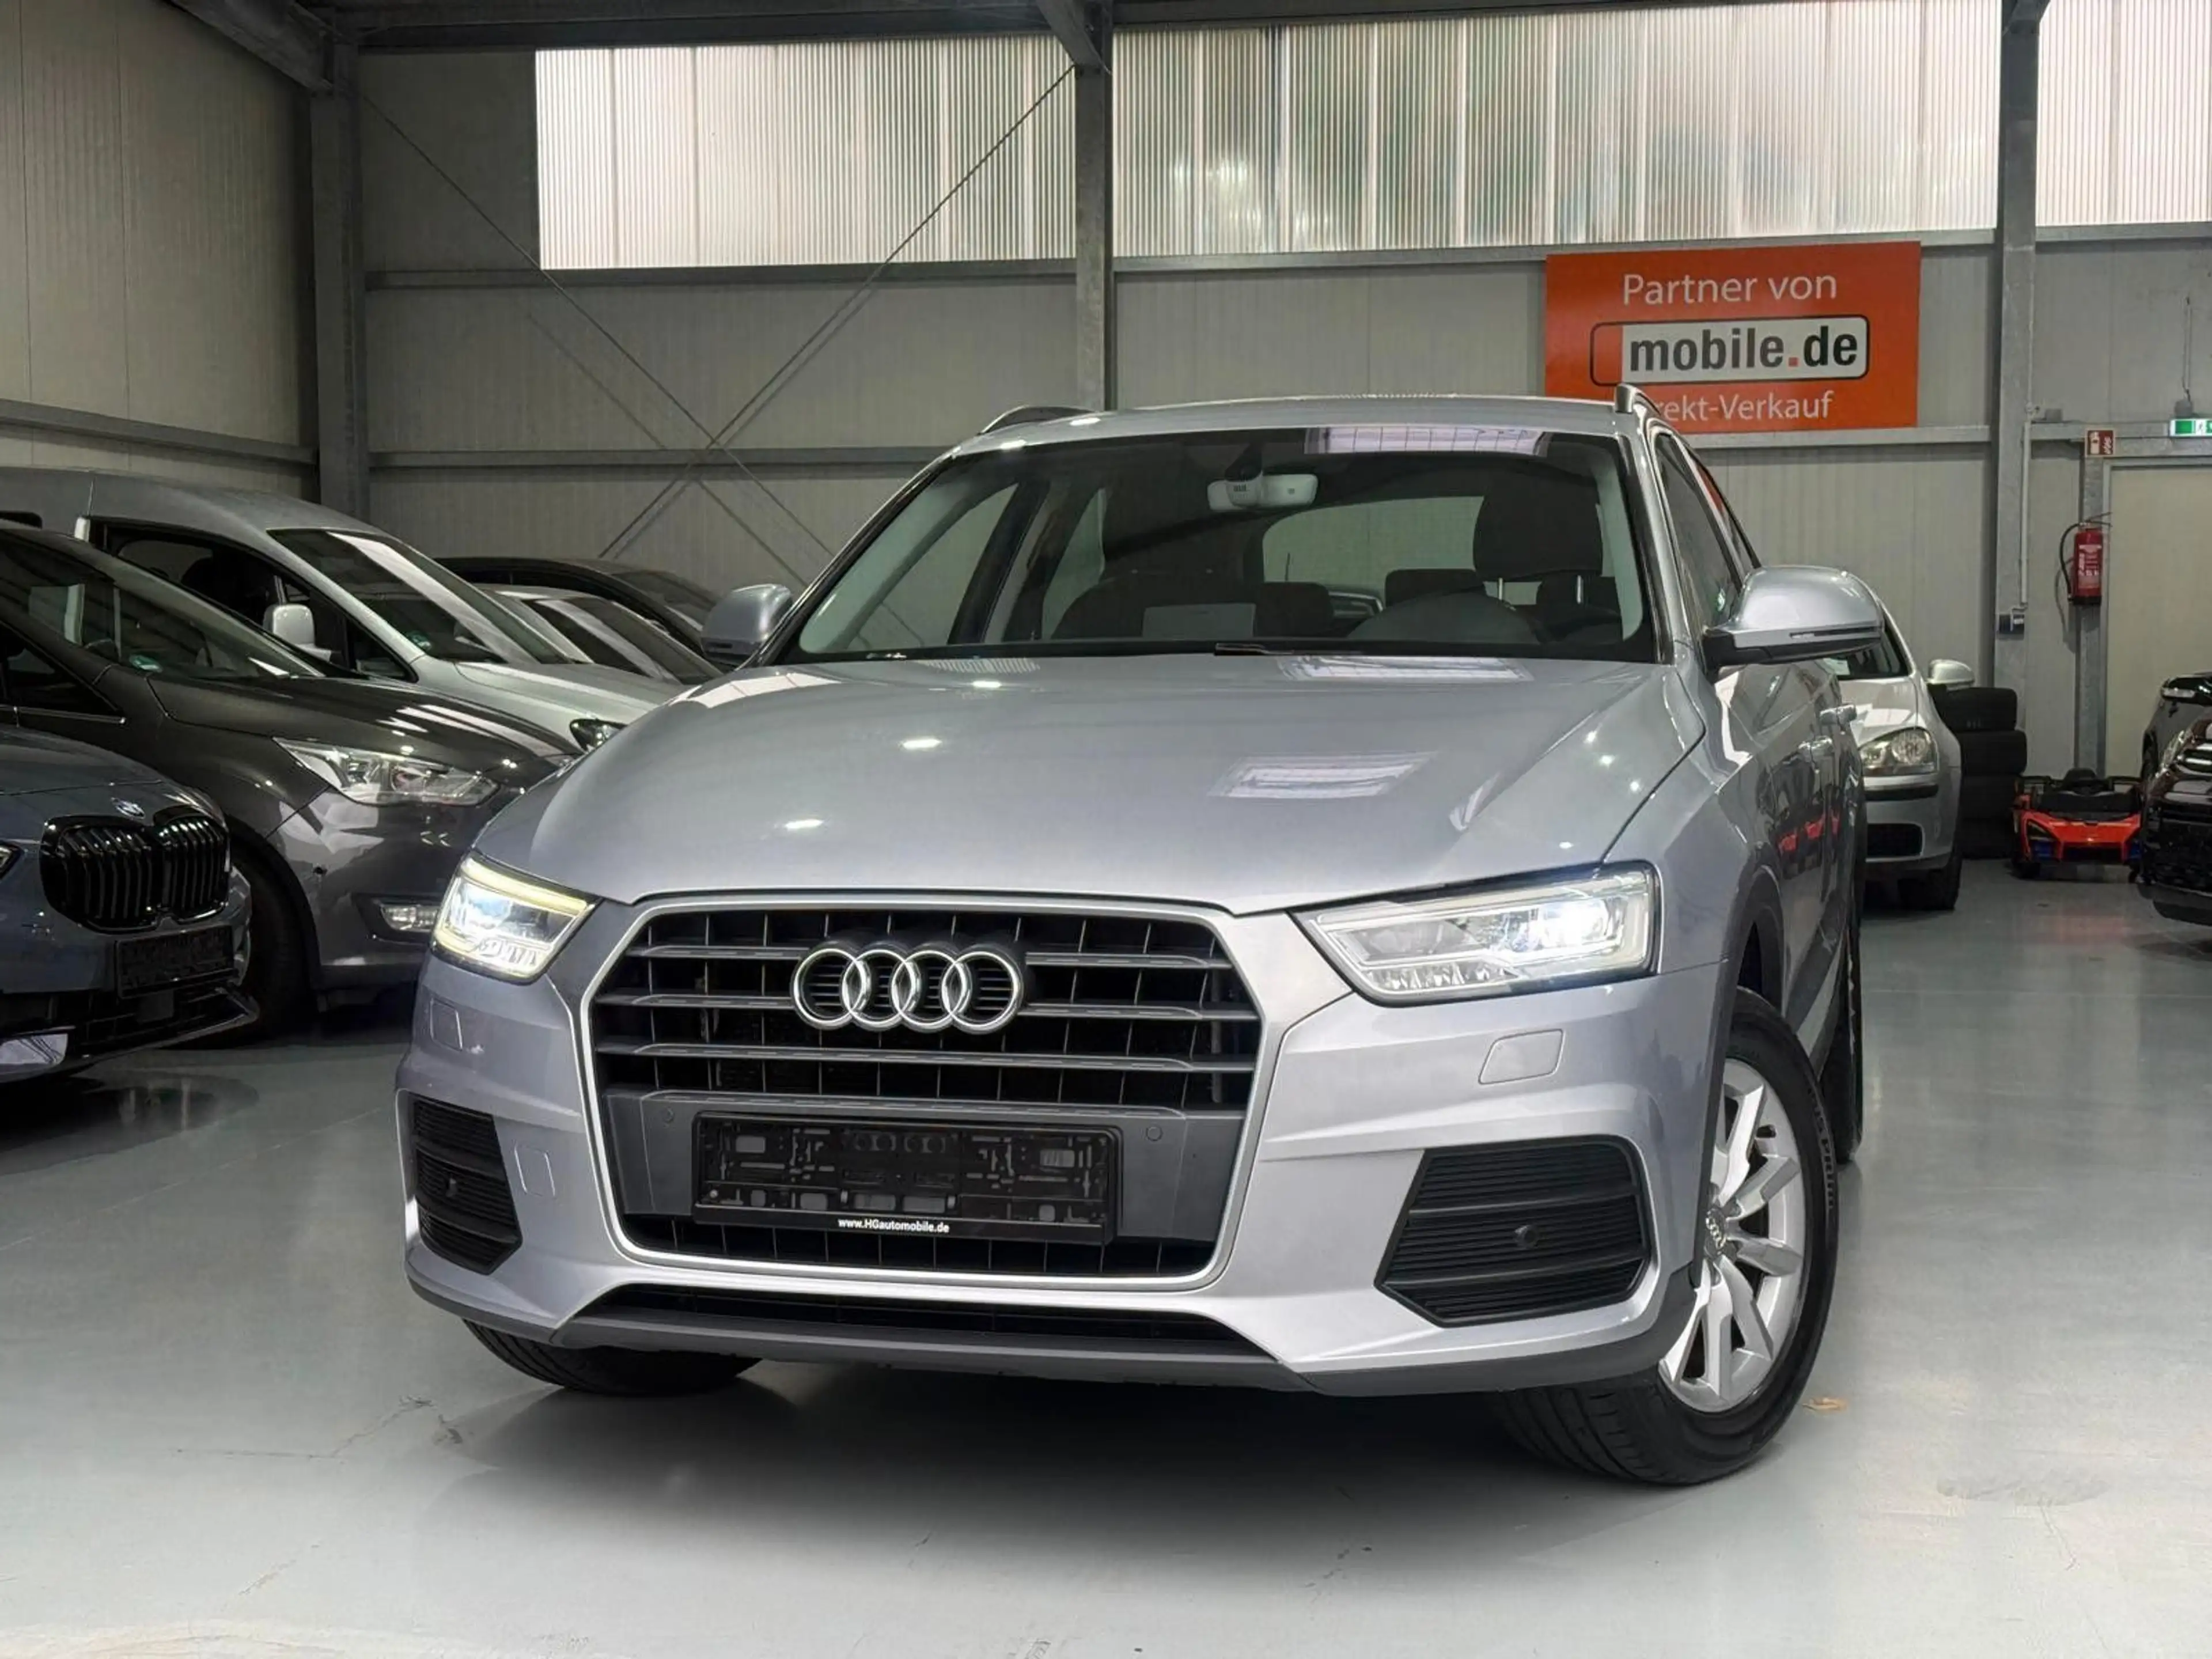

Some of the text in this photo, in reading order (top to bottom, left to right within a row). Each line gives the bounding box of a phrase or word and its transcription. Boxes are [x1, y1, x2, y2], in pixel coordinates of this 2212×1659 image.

[1623, 274, 1837, 305] Partner von
[1630, 325, 1858, 372] mobile.de
[838, 1218, 950, 1233] www.HGautomobile.de
